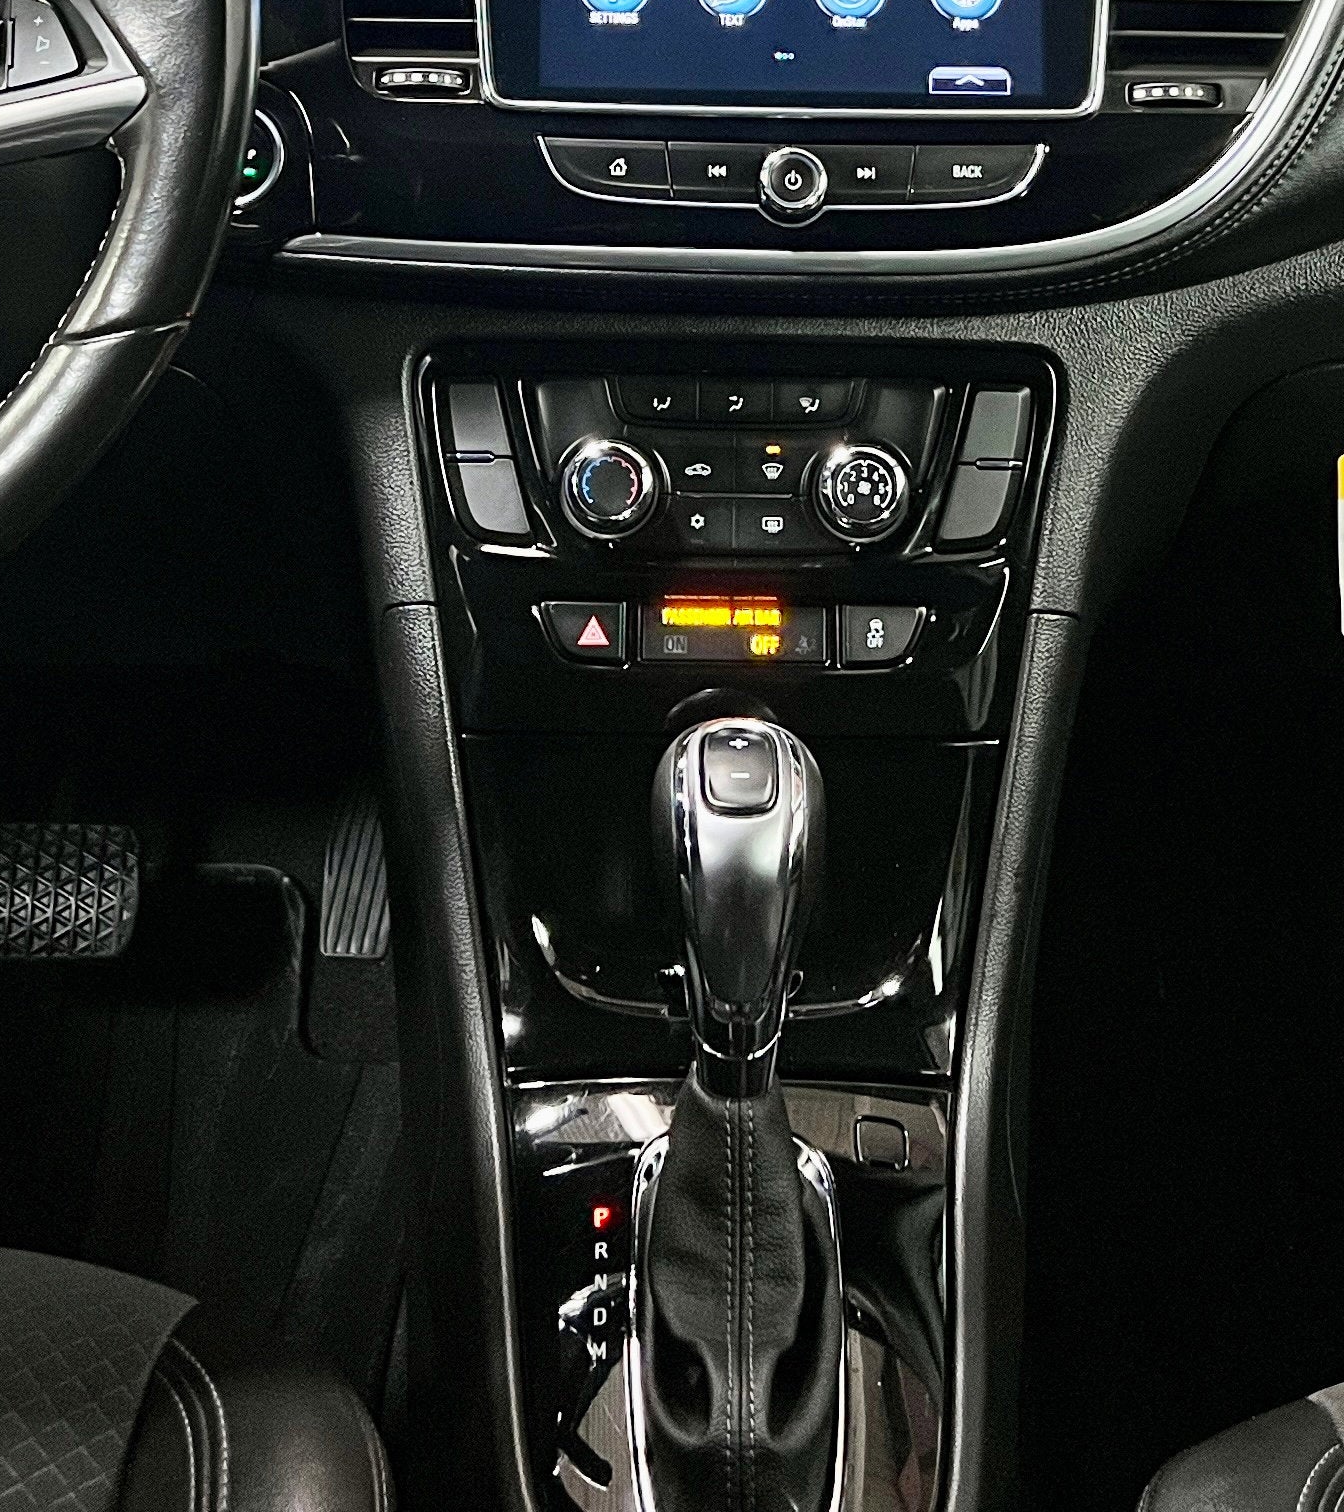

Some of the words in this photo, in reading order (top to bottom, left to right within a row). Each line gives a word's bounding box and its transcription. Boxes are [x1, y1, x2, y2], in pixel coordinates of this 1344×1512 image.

[588, 10, 639, 25] SETTINGS
[719, 13, 746, 27] TEXT
[952, 164, 983, 178] BACK
[849, 470, 856, 482] 2
[860, 466, 868, 478] 3
[871, 470, 880, 482] 4
[878, 482, 885, 494] 5
[846, 493, 855, 505] 0
[664, 635, 688, 653] ON
[750, 634, 780, 655] OFF
[593, 1206, 610, 1228] P
[594, 1241, 609, 1260] R
[594, 1273, 608, 1289] N
[593, 1307, 607, 1326] D
[592, 1341, 607, 1360] M
